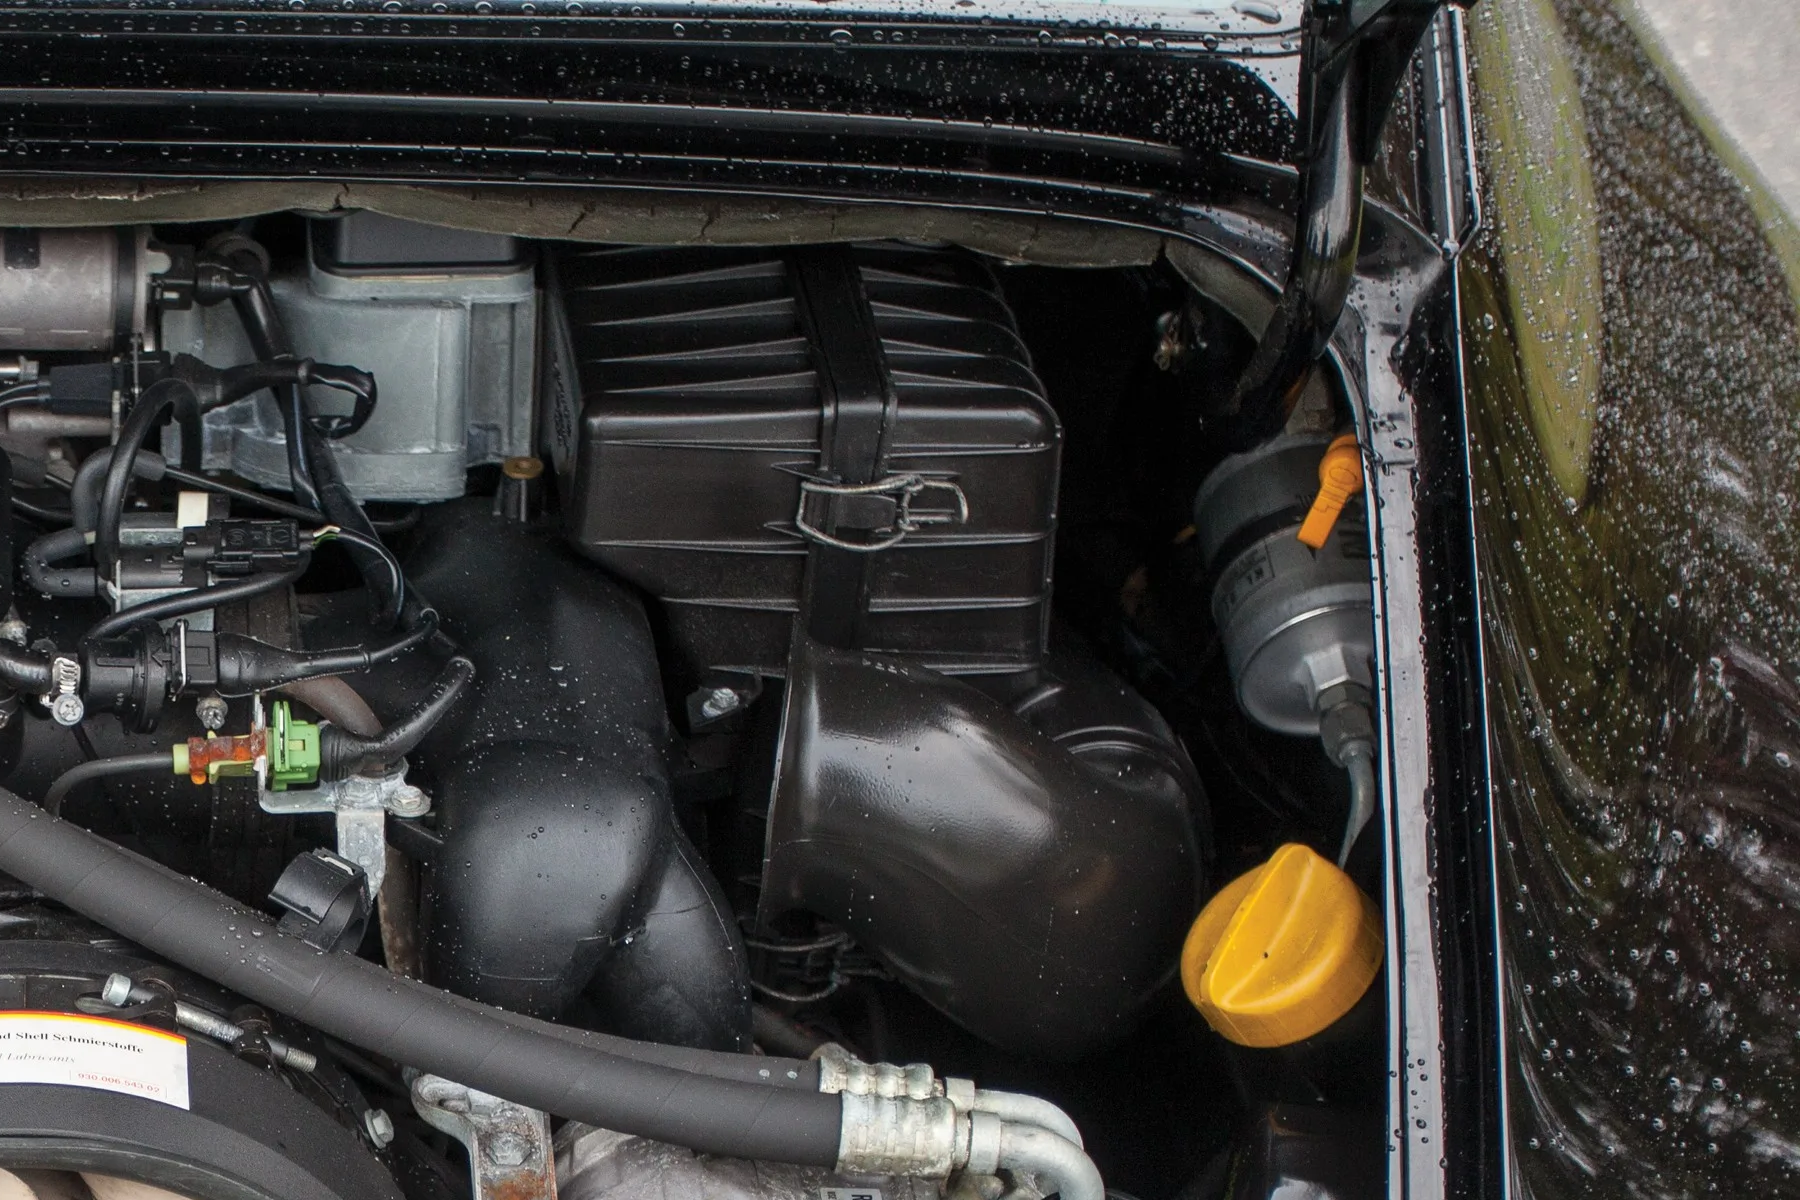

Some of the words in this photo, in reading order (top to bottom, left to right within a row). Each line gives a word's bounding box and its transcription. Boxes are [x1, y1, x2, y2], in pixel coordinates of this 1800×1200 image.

[15, 1032, 49, 1040] Shell
[52, 1034, 144, 1054] Schmierstoffe
[7, 1052, 76, 1064] Lubricants
